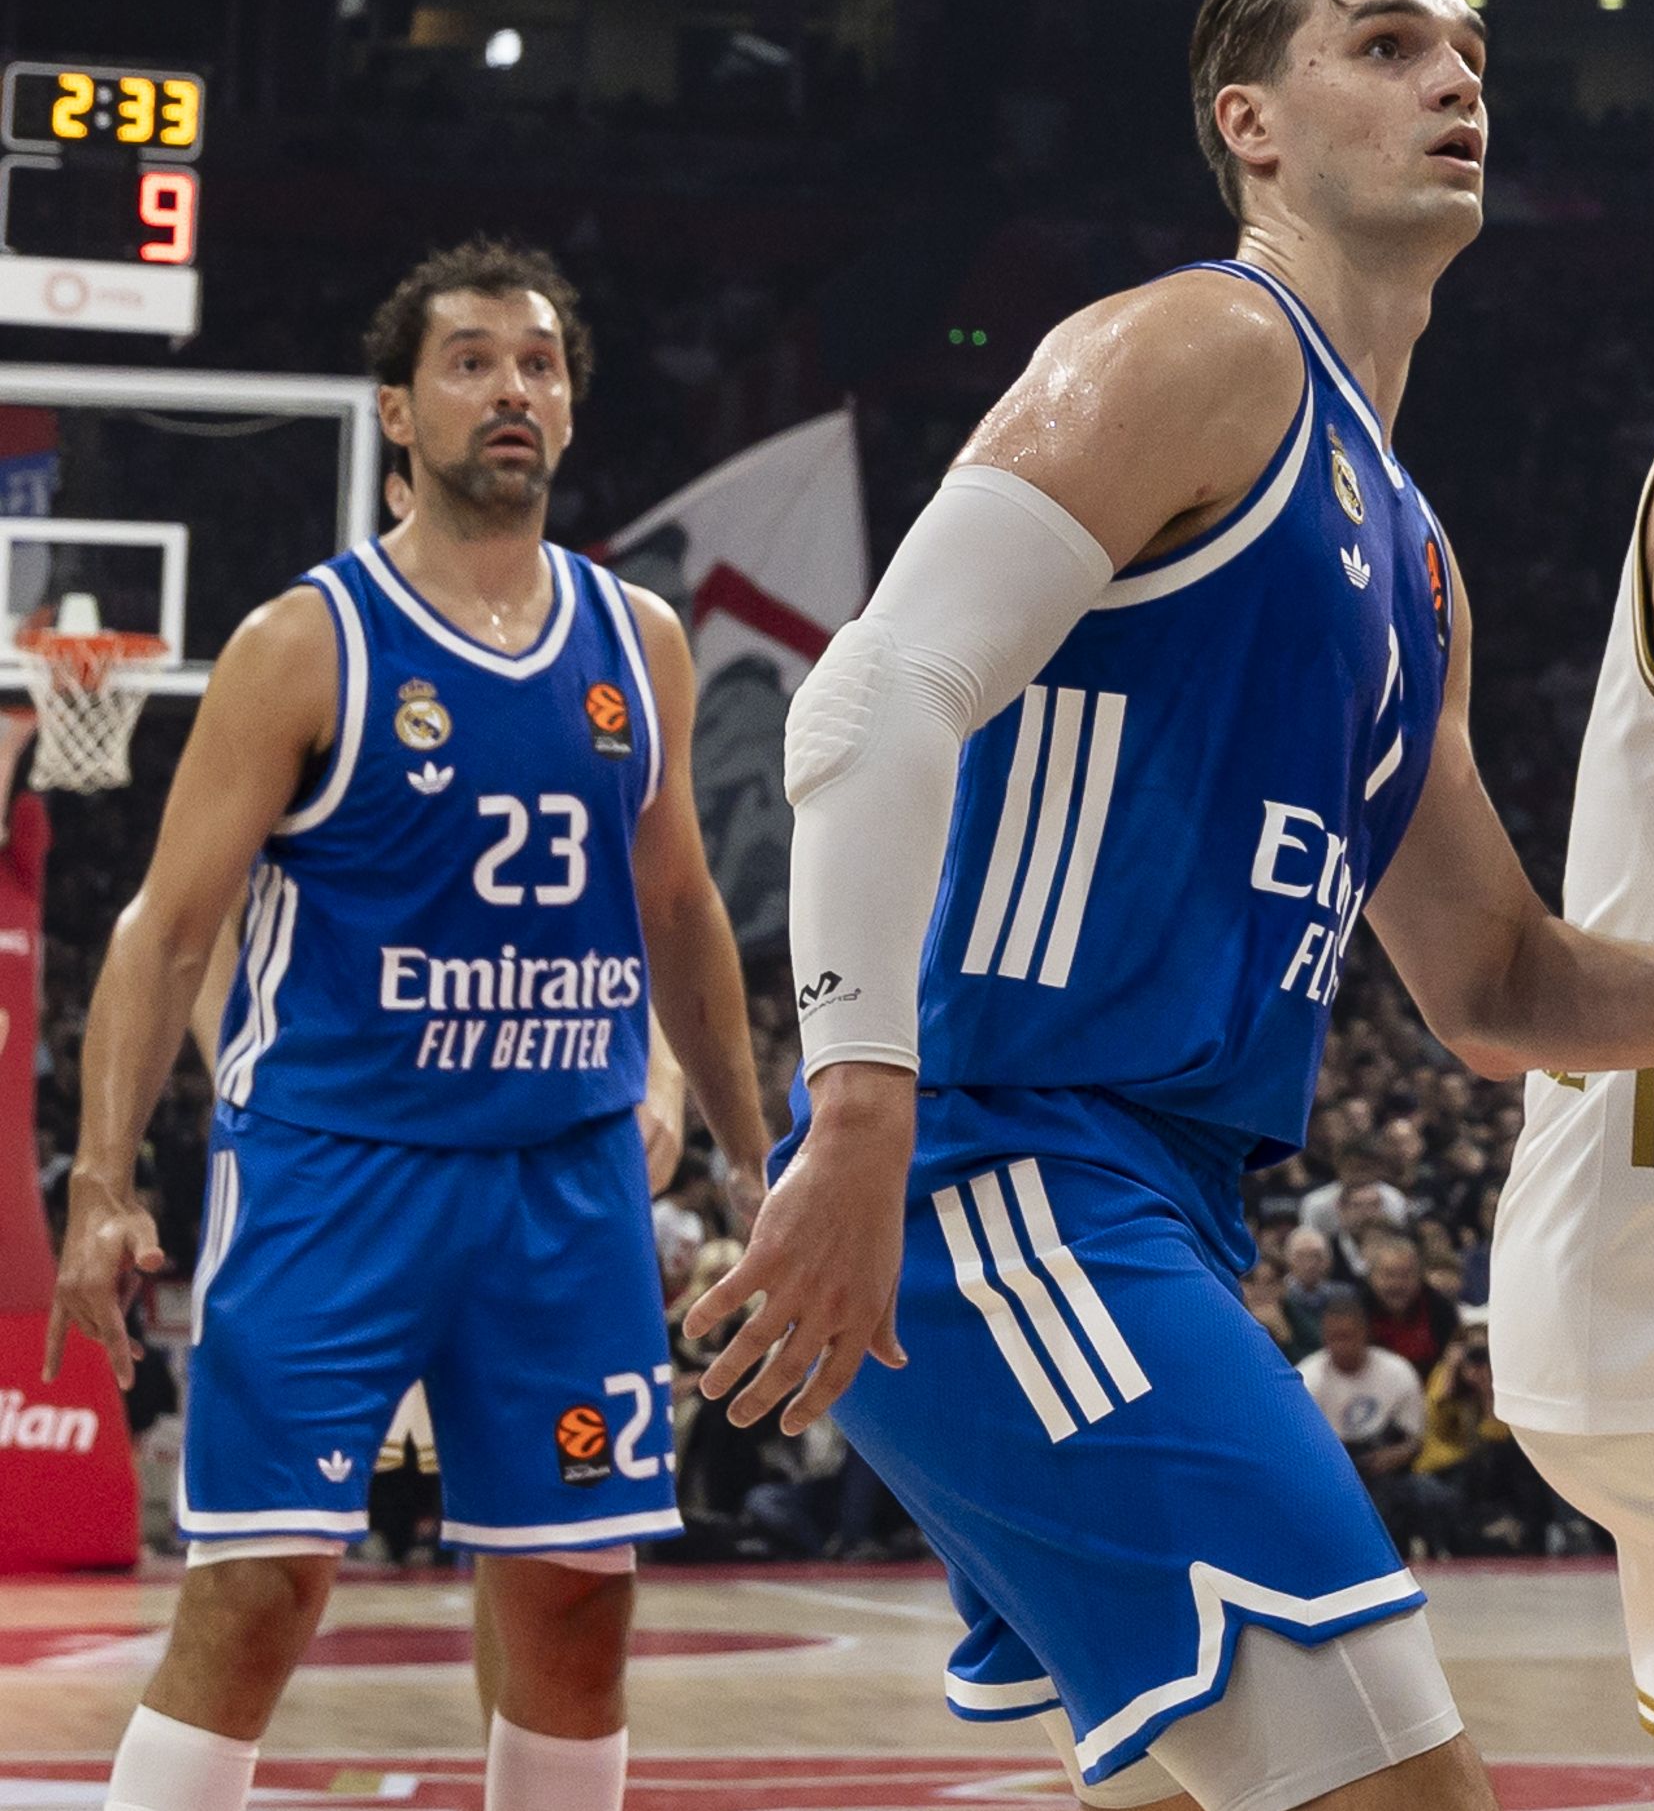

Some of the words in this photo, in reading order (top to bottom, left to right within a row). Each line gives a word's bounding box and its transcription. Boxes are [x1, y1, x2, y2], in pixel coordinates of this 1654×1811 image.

[52, 73, 199, 146] 2:33
[140, 171, 196, 264] 9
[472, 793, 589, 906] 23
[380, 944, 642, 1011] Emirates
[415, 1019, 487, 1070] FLY
[490, 1018, 612, 1071] BETTER
